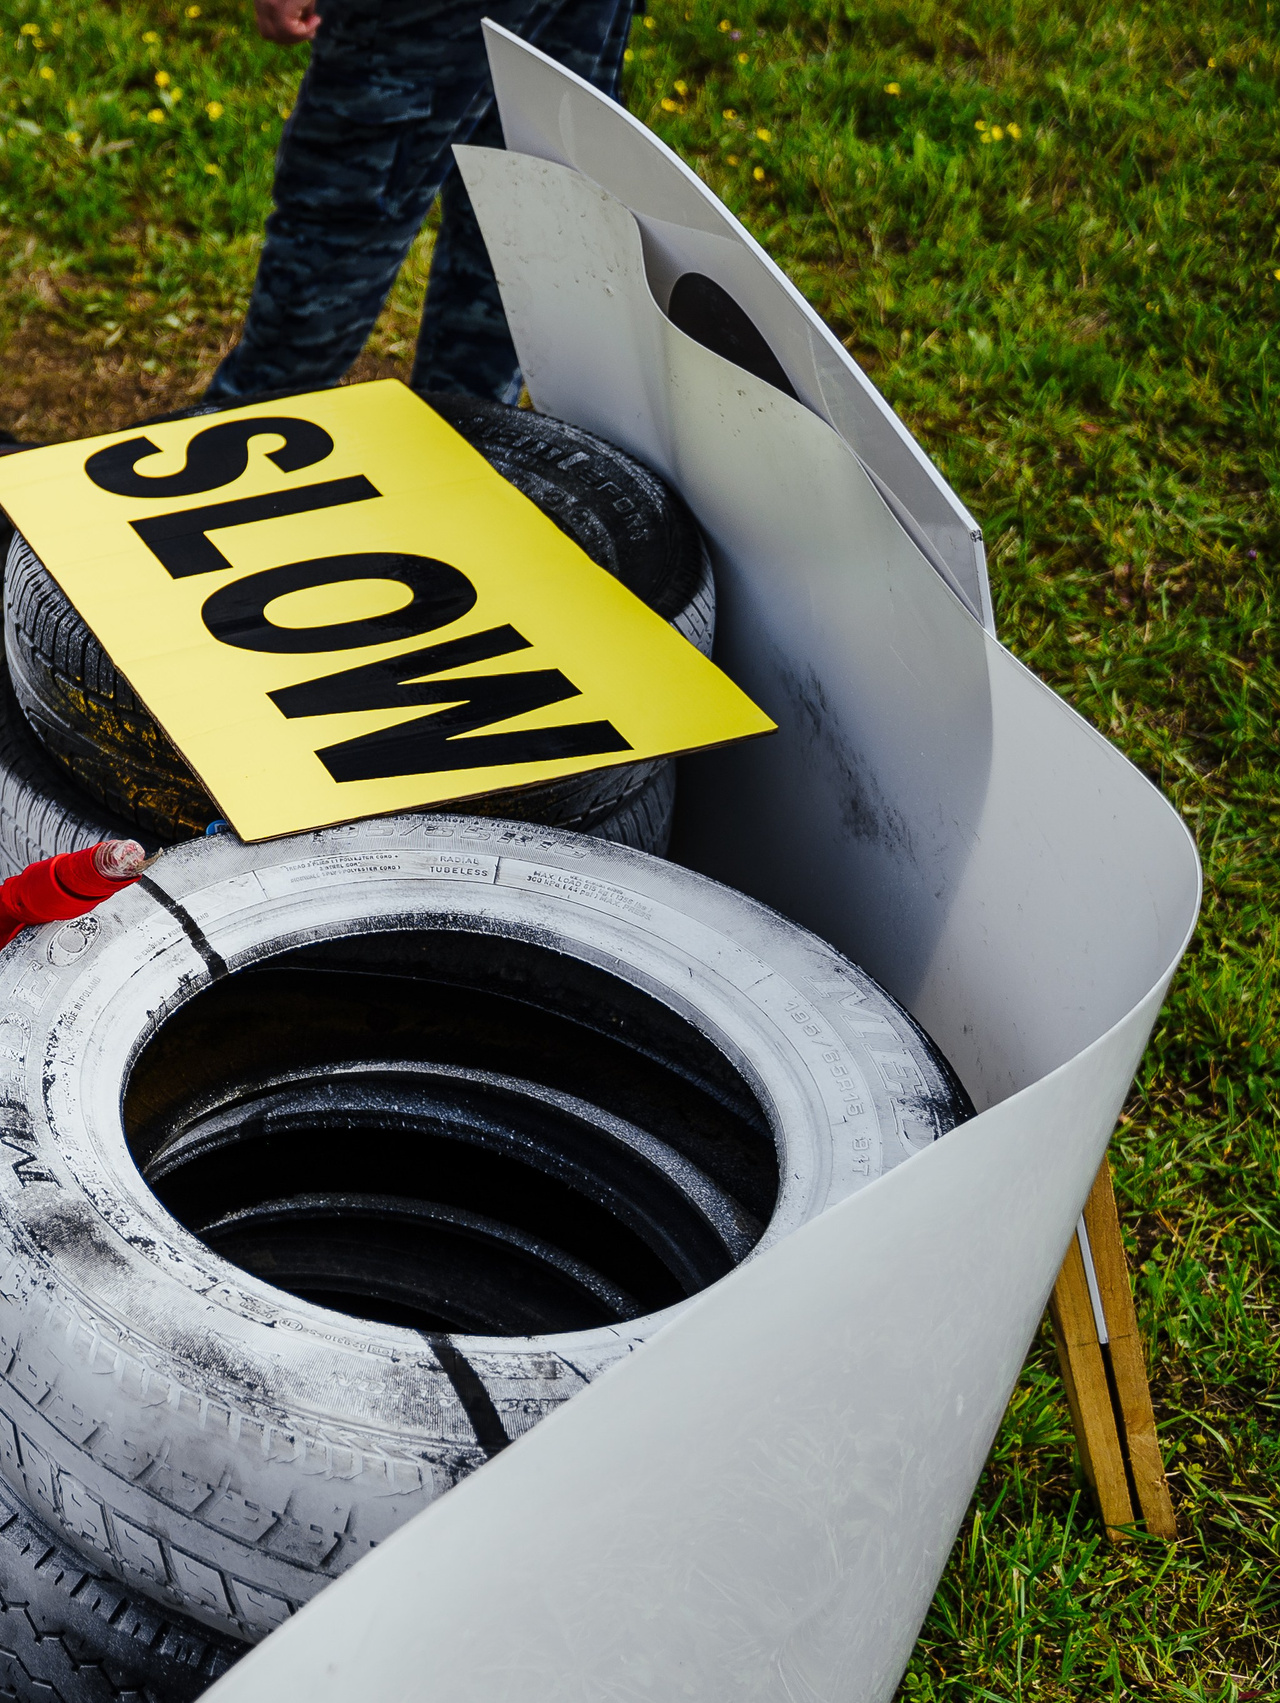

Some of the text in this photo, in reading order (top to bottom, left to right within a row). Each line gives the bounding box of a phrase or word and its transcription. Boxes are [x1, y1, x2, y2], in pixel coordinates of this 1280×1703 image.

[84, 416, 634, 783] SLOW
[429, 865, 489, 878] TUBELESS
[439, 854, 480, 866] RADIAL
[557, 875, 582, 887] LOAD
[79, 976, 102, 1006] POLAND
[800, 974, 941, 1158] MED
[784, 1000, 870, 1177] 195/65R15 91T
